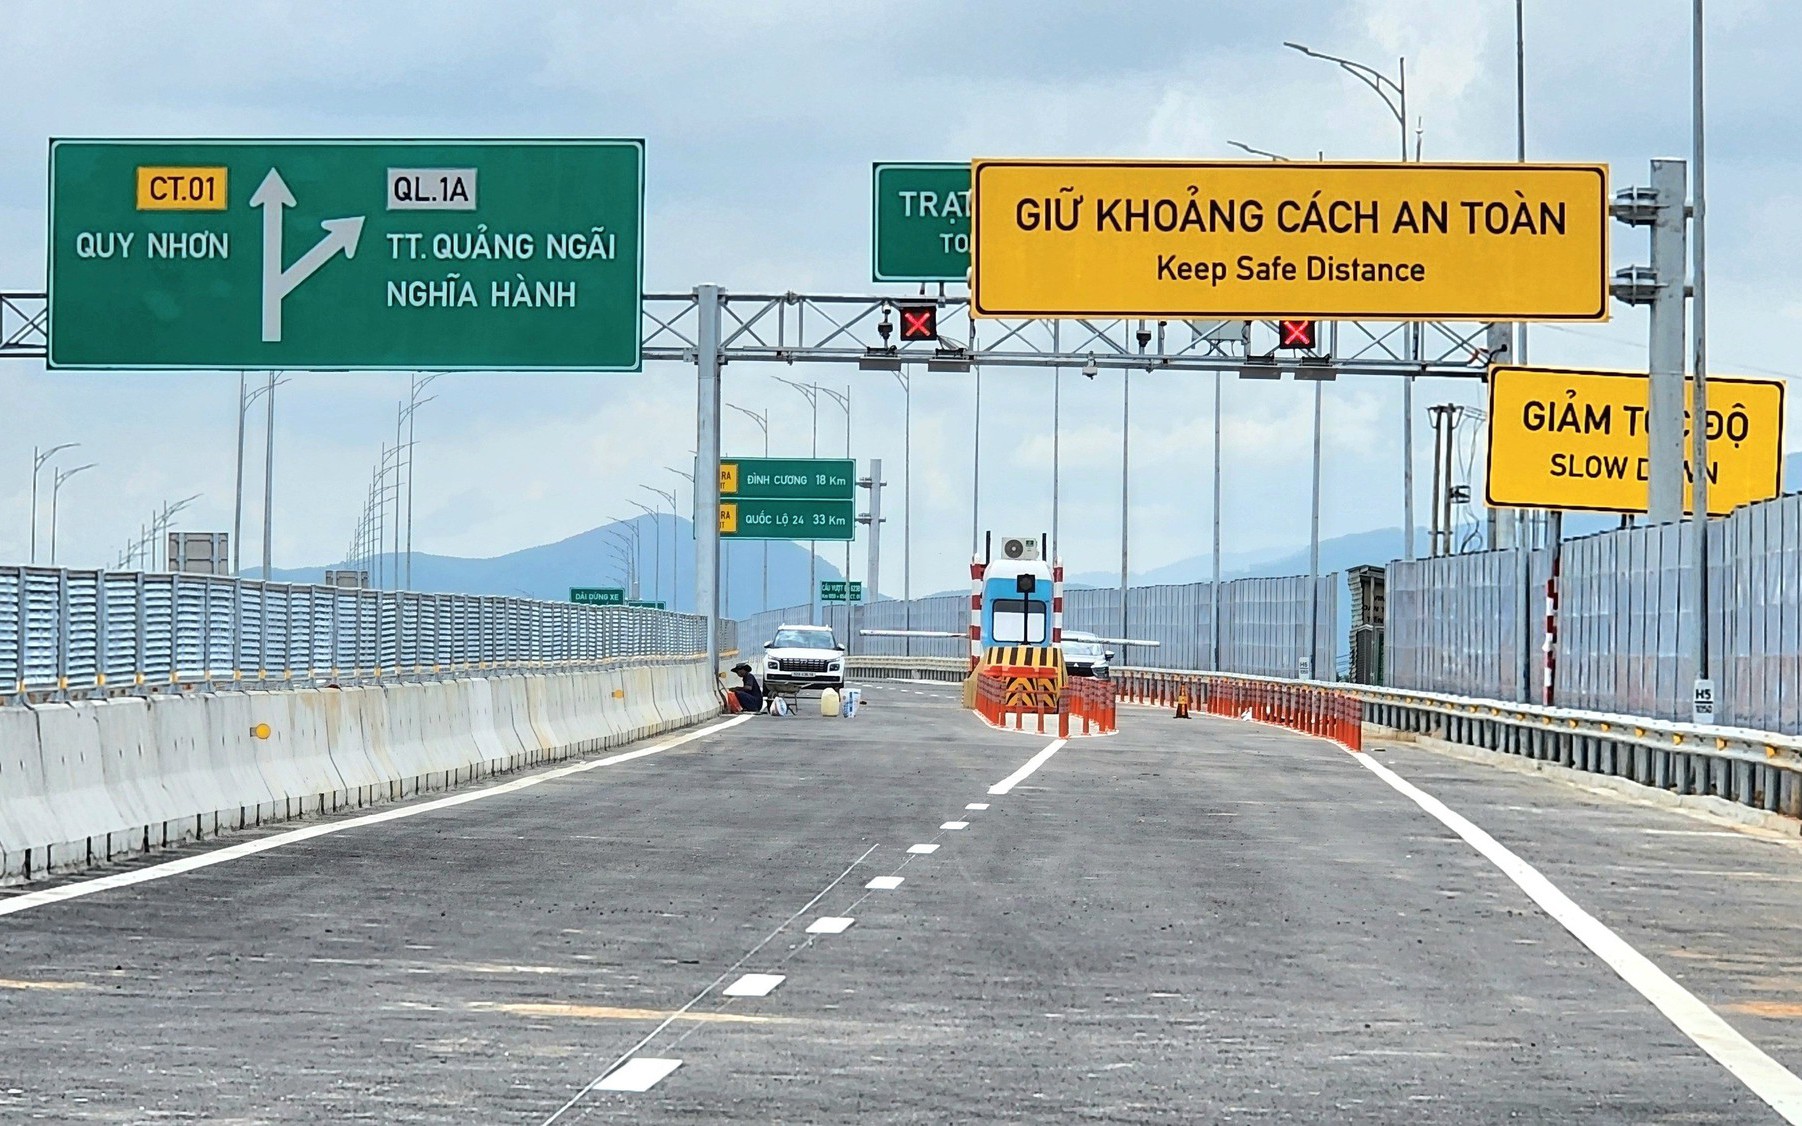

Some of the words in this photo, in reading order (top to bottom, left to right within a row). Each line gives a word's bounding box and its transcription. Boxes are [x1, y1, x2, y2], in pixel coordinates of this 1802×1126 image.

[150, 176, 215, 202] CT.01
[394, 176, 469, 202] QL.1A
[1016, 186, 1084, 232] GIỮ
[1097, 185, 1264, 233] KHOẢNG
[1277, 189, 1379, 234] CÁCH
[1391, 200, 1448, 234] AN
[1461, 189, 1566, 235] TOÀN
[76, 231, 135, 258] QUY
[148, 230, 228, 257] NHƠN
[433, 223, 534, 260] QUẢNG
[546, 226, 615, 260] NGÃI
[1157, 255, 1227, 287] Keep
[1236, 254, 1297, 281] Safe
[1307, 255, 1425, 282] Distance
[387, 273, 478, 308] NGHĨA
[491, 274, 576, 308] HÀNH
[1523, 389, 1611, 435] GIẢM
[1705, 402, 1749, 449] ĐỘ
[721, 471, 732, 480] RA
[747, 472, 770, 485] ĐÌNH
[773, 475, 808, 486] CƯƠNG
[815, 474, 827, 485] 18
[829, 476, 846, 487] Km
[1550, 453, 1629, 480] SLOW
[720, 511, 731, 519] RA
[745, 510, 772, 525] QUỐC
[776, 513, 789, 527] LỘ
[792, 515, 804, 525] 24
[812, 514, 826, 525] 33
[828, 514, 846, 526] Km
[610, 593, 619, 601] XE
[1695, 688, 1711, 699] H5
